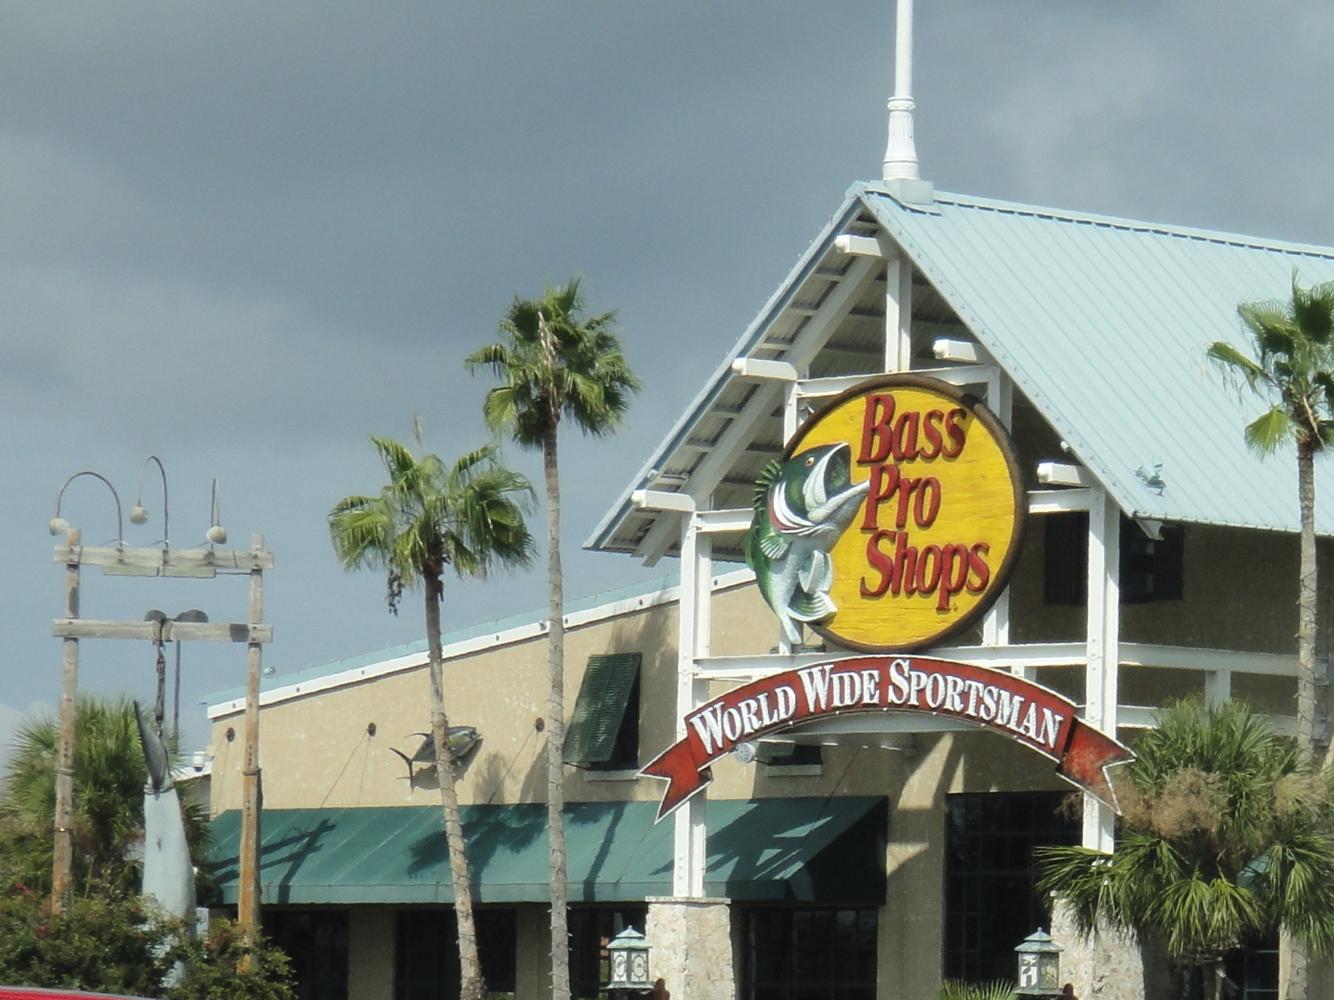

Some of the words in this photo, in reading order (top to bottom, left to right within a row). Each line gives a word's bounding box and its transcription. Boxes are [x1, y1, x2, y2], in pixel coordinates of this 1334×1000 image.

[857, 391, 968, 466] Bass
[860, 463, 942, 532] Pro
[859, 528, 991, 612] Shops
[687, 683, 797, 756] WORLD
[797, 663, 881, 716] WIDE
[887, 657, 1064, 750] SPORTSMAN
